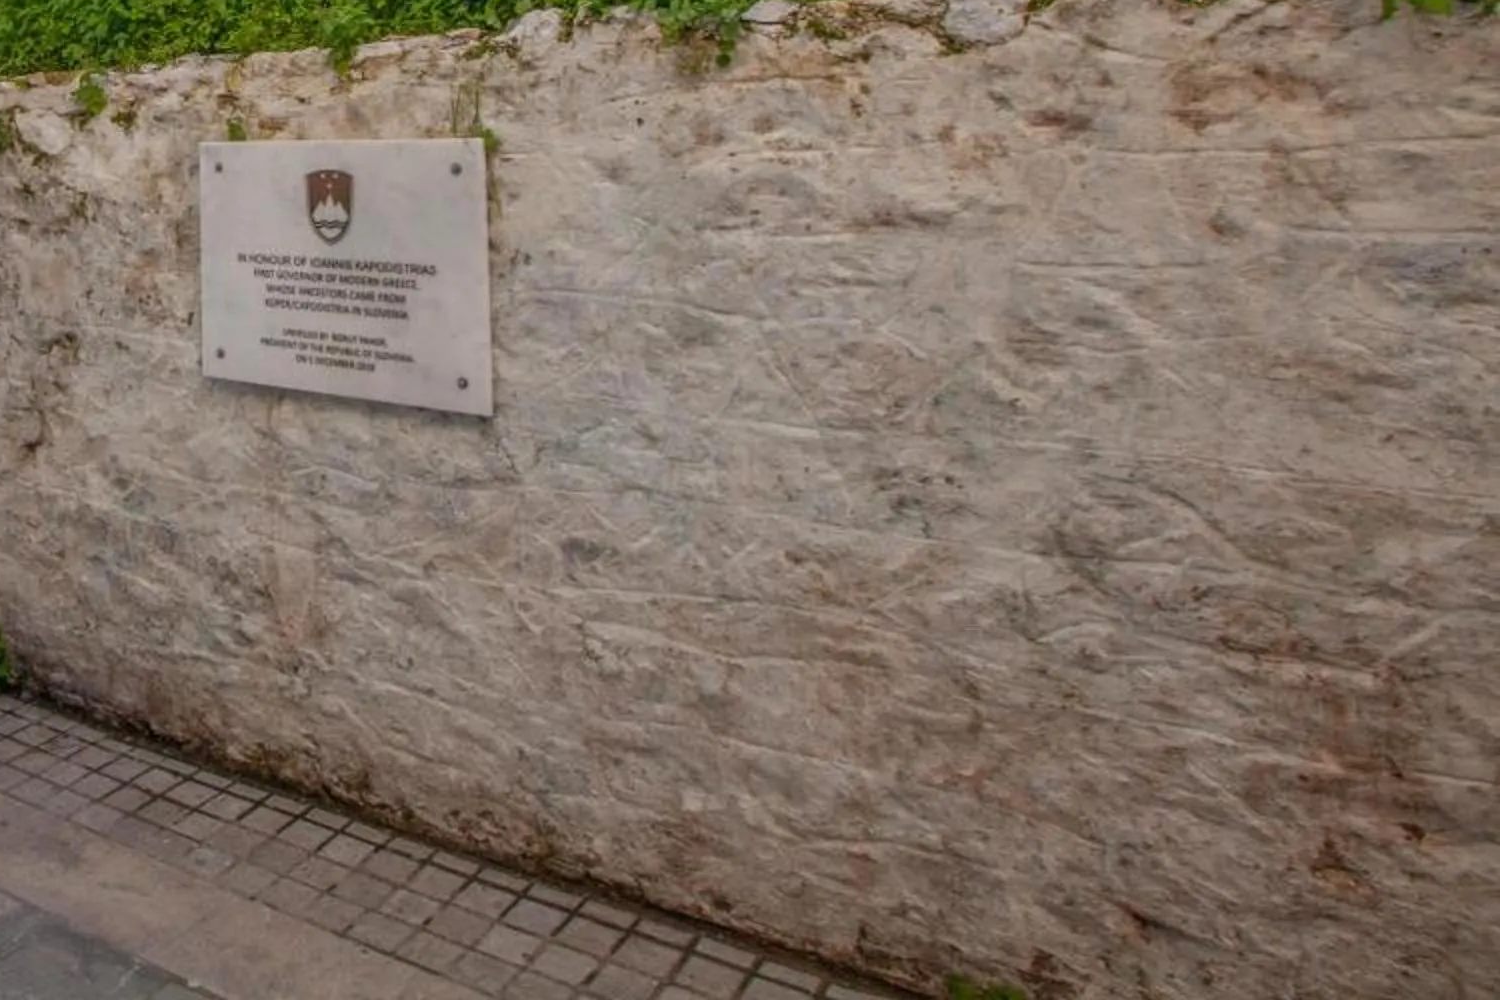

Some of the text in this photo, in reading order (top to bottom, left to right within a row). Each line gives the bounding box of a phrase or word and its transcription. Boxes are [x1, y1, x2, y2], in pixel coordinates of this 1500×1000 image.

[248, 254, 292, 266] HONOUR
[293, 256, 306, 267] OF
[325, 274, 337, 283] OF
